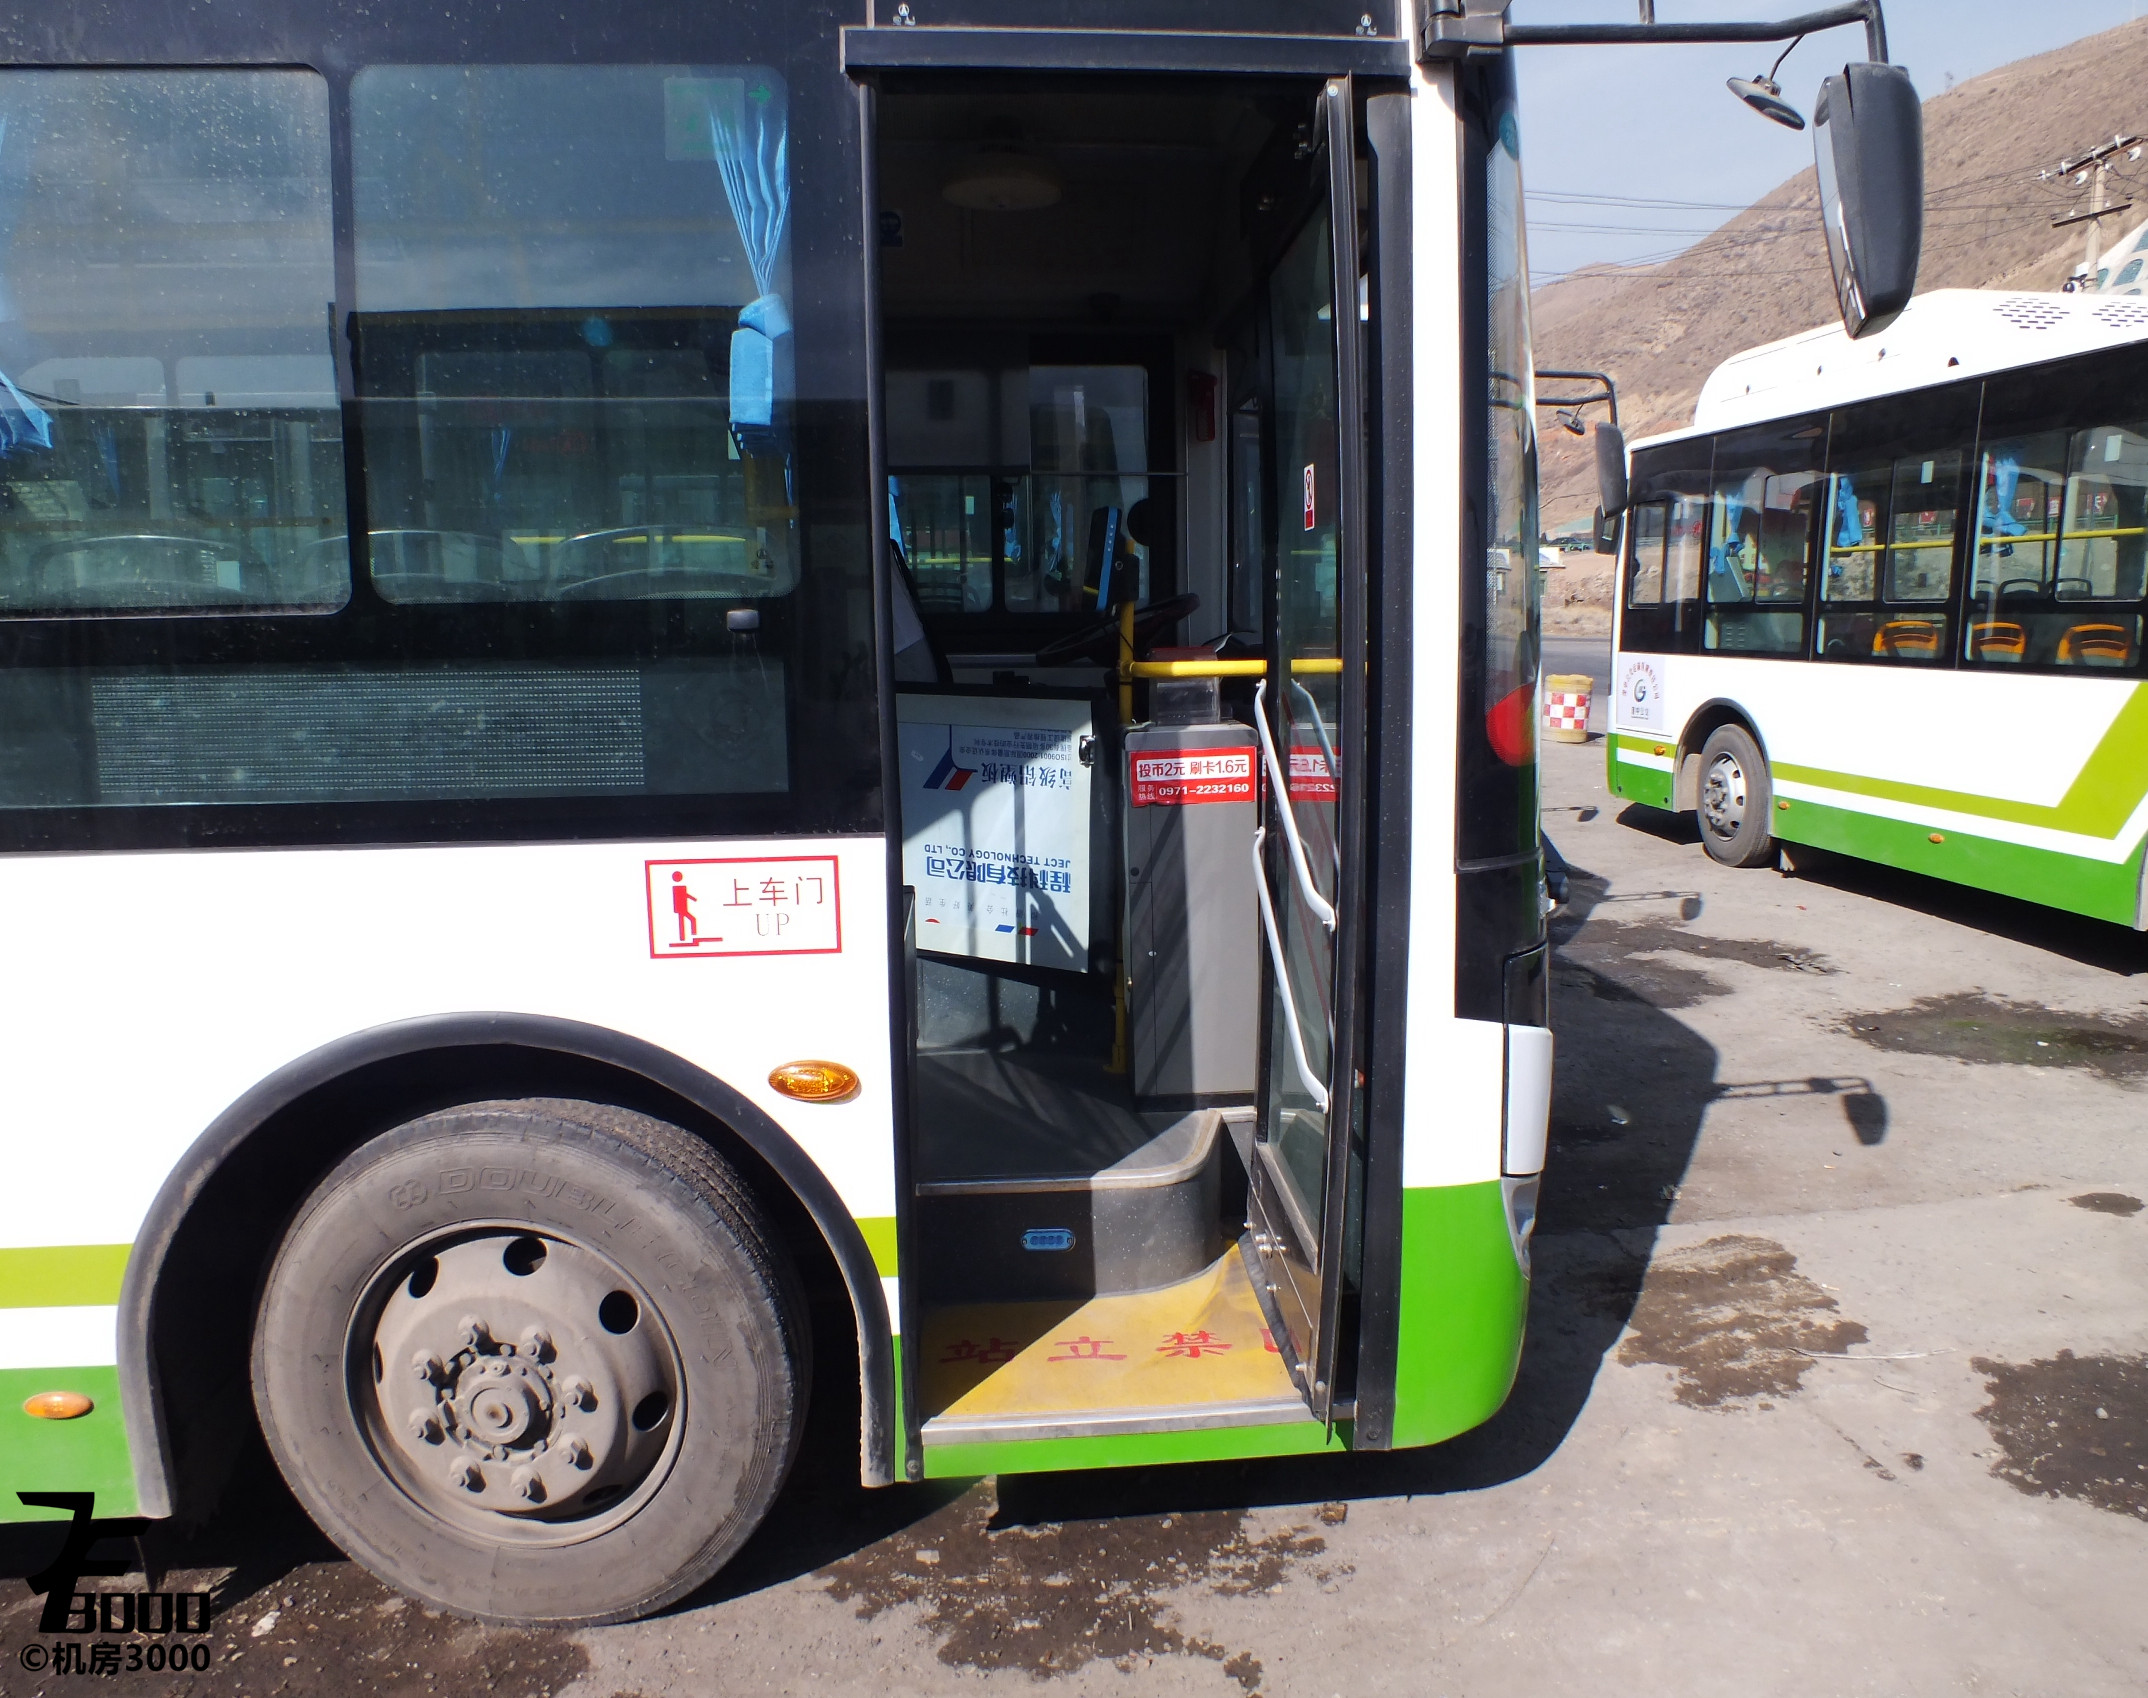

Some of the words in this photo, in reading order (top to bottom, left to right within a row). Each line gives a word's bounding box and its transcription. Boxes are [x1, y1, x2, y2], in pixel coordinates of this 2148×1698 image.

[981, 762, 1072, 790] 高级铝塑板
[1138, 762, 1185, 778] 投币2元
[1189, 759, 1247, 775] 刷卡1.6元
[1138, 784, 1155, 792] 服务
[1158, 783, 1249, 796] 0971-2232160
[924, 844, 943, 853] LTD
[969, 848, 1040, 865] TECHNOLOGY
[1044, 857, 1071, 869] JECT
[926, 856, 1071, 893] 程科技有限公司
[723, 876, 823, 906] 上车门
[756, 913, 790, 936] UP
